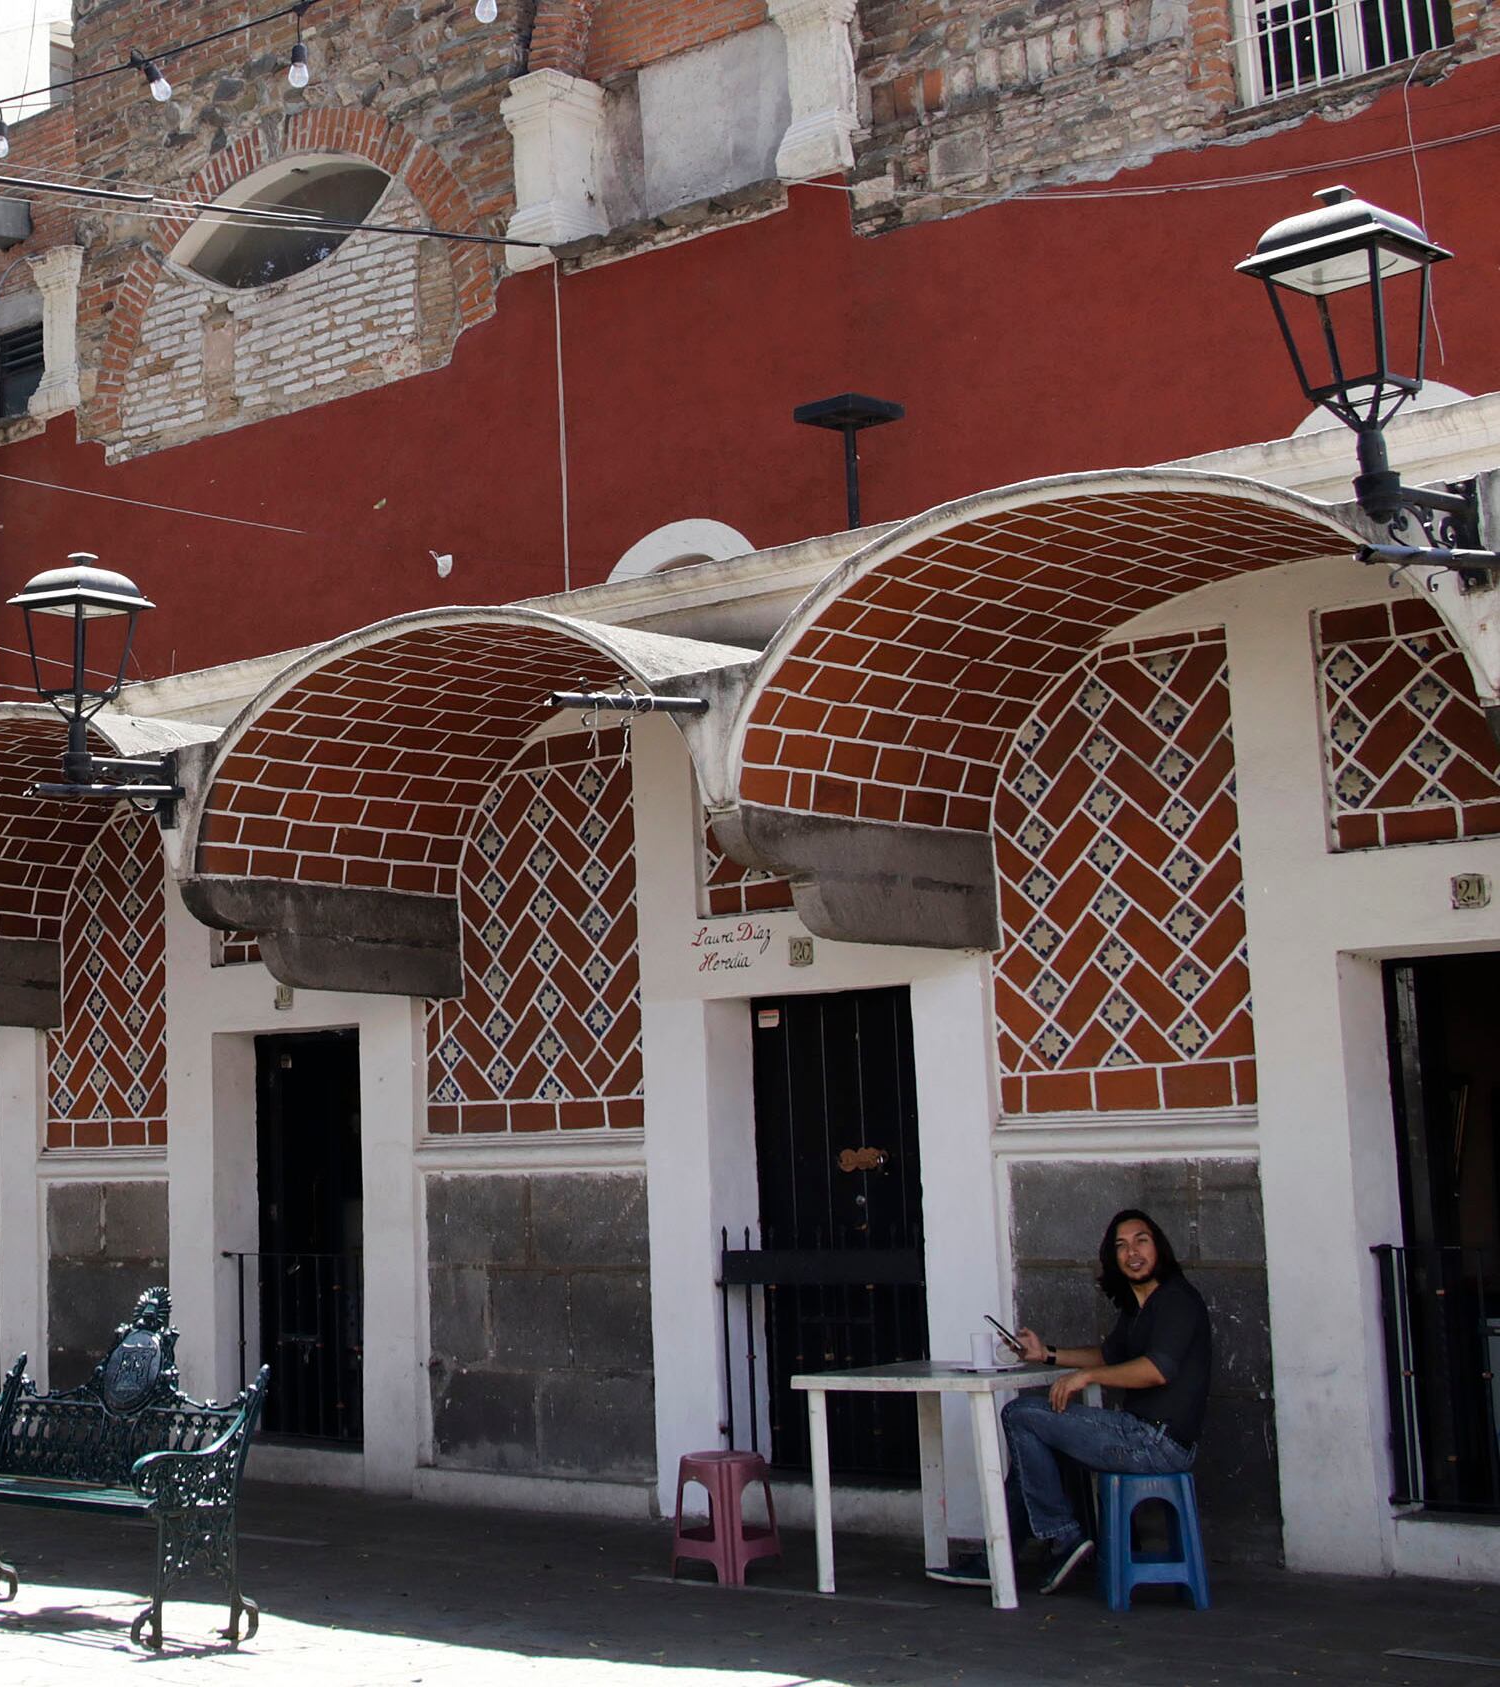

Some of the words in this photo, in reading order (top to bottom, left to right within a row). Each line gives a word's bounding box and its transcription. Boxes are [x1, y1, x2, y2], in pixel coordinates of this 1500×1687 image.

[691, 926, 734, 947] Laura
[792, 940, 811, 961] 20
[698, 951, 752, 973] Heredia
